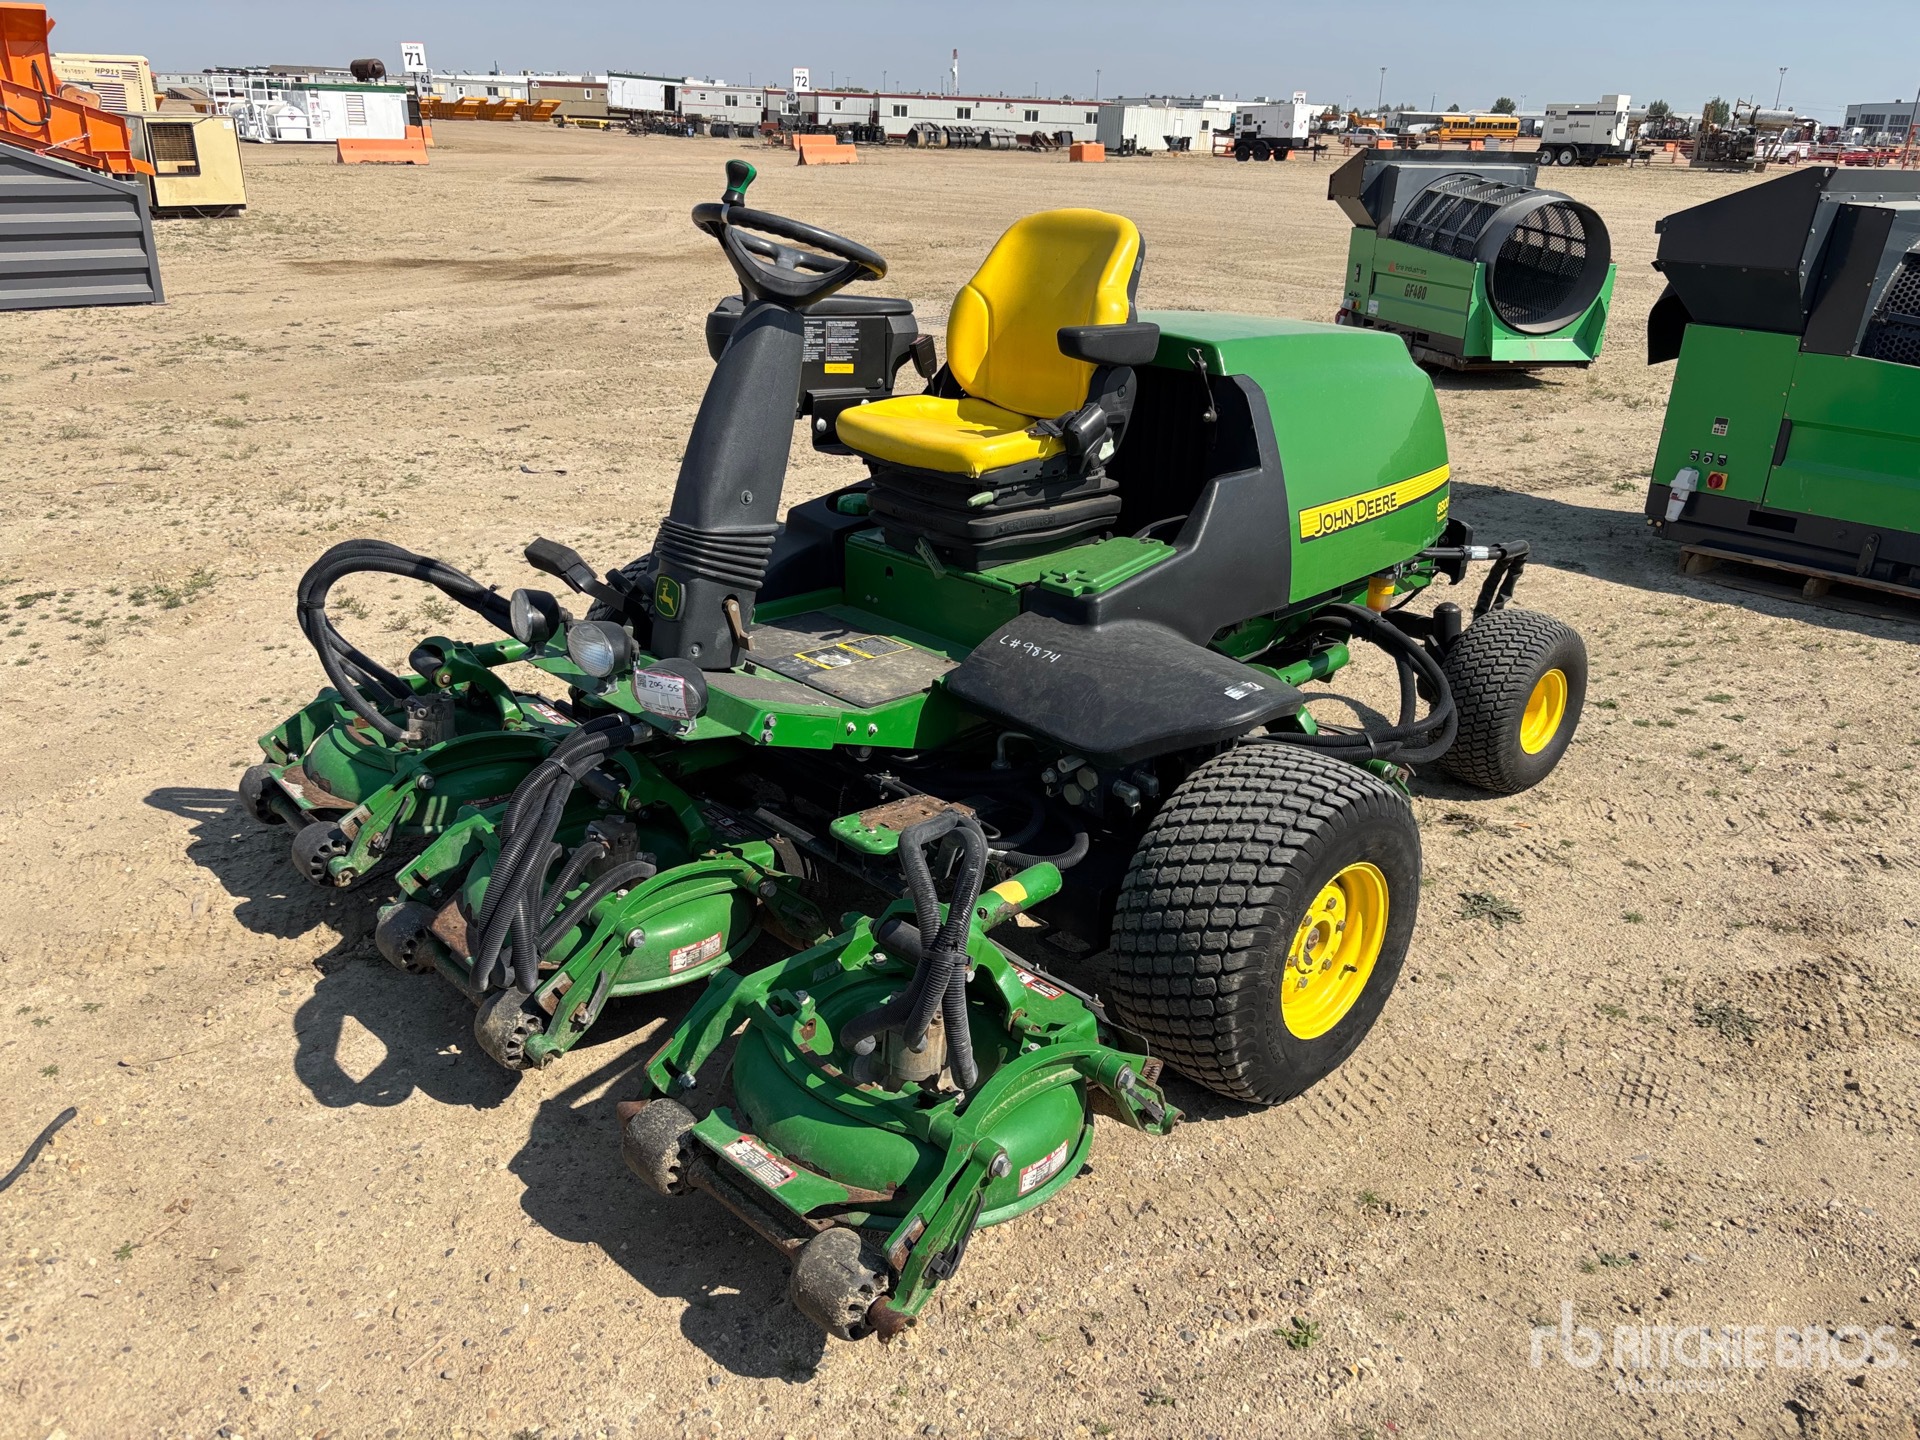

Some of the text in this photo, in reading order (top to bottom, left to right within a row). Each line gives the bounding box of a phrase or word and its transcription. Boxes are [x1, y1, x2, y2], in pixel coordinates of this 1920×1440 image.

[404, 52, 424, 66] 71
[420, 74, 431, 84] 61
[795, 75, 808, 87] 72
[786, 93, 796, 101] 60
[1404, 283, 1428, 301] GF480
[1314, 491, 1398, 534] JOHN DEERE
